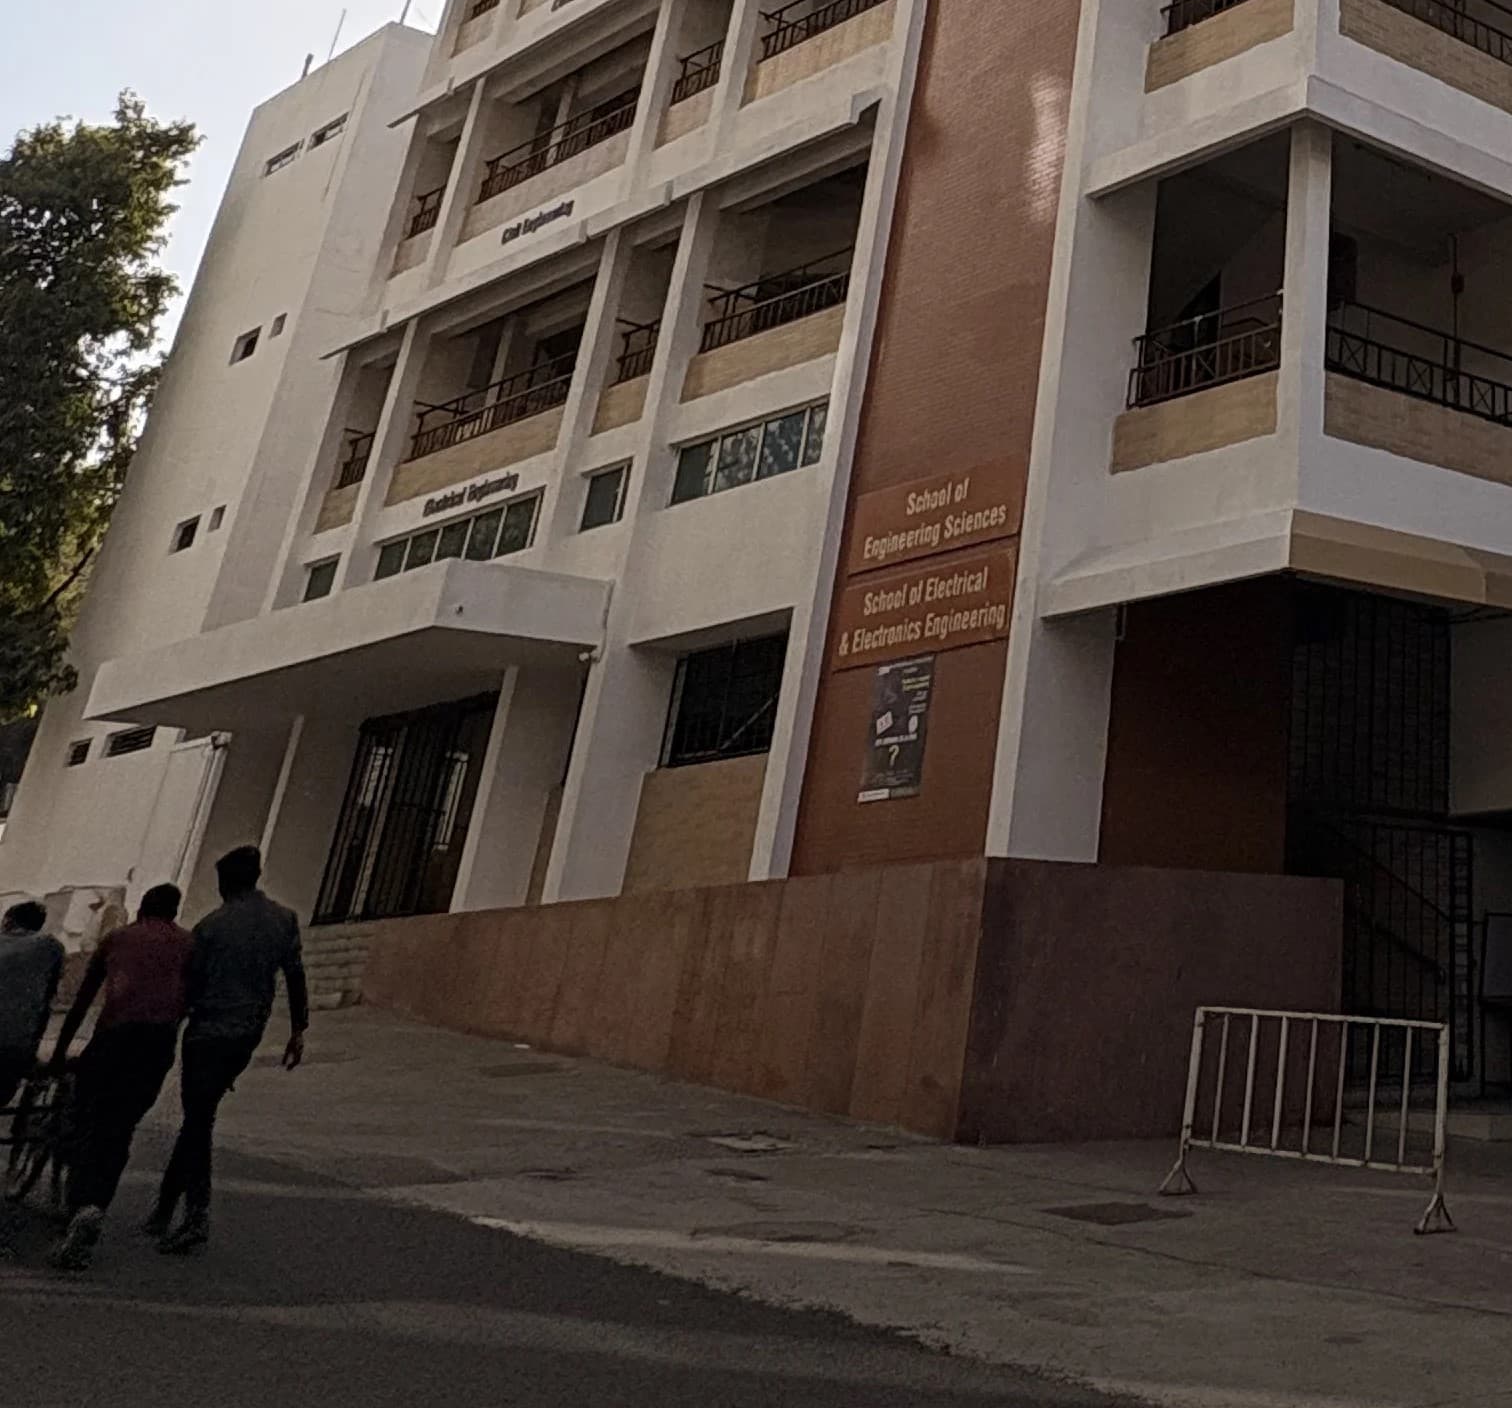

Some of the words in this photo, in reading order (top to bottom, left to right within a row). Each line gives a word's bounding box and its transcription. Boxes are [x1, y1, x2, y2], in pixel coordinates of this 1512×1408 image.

[906, 481, 951, 515] School
[954, 477, 970, 501] of
[863, 522, 941, 560] Engineering
[943, 504, 1007, 539] Sciences
[863, 584, 907, 616] School
[909, 580, 924, 606] of
[925, 565, 988, 602] Electrical
[838, 632, 849, 657] &
[851, 617, 922, 654] Electronics
[924, 600, 1006, 640] Engineering
